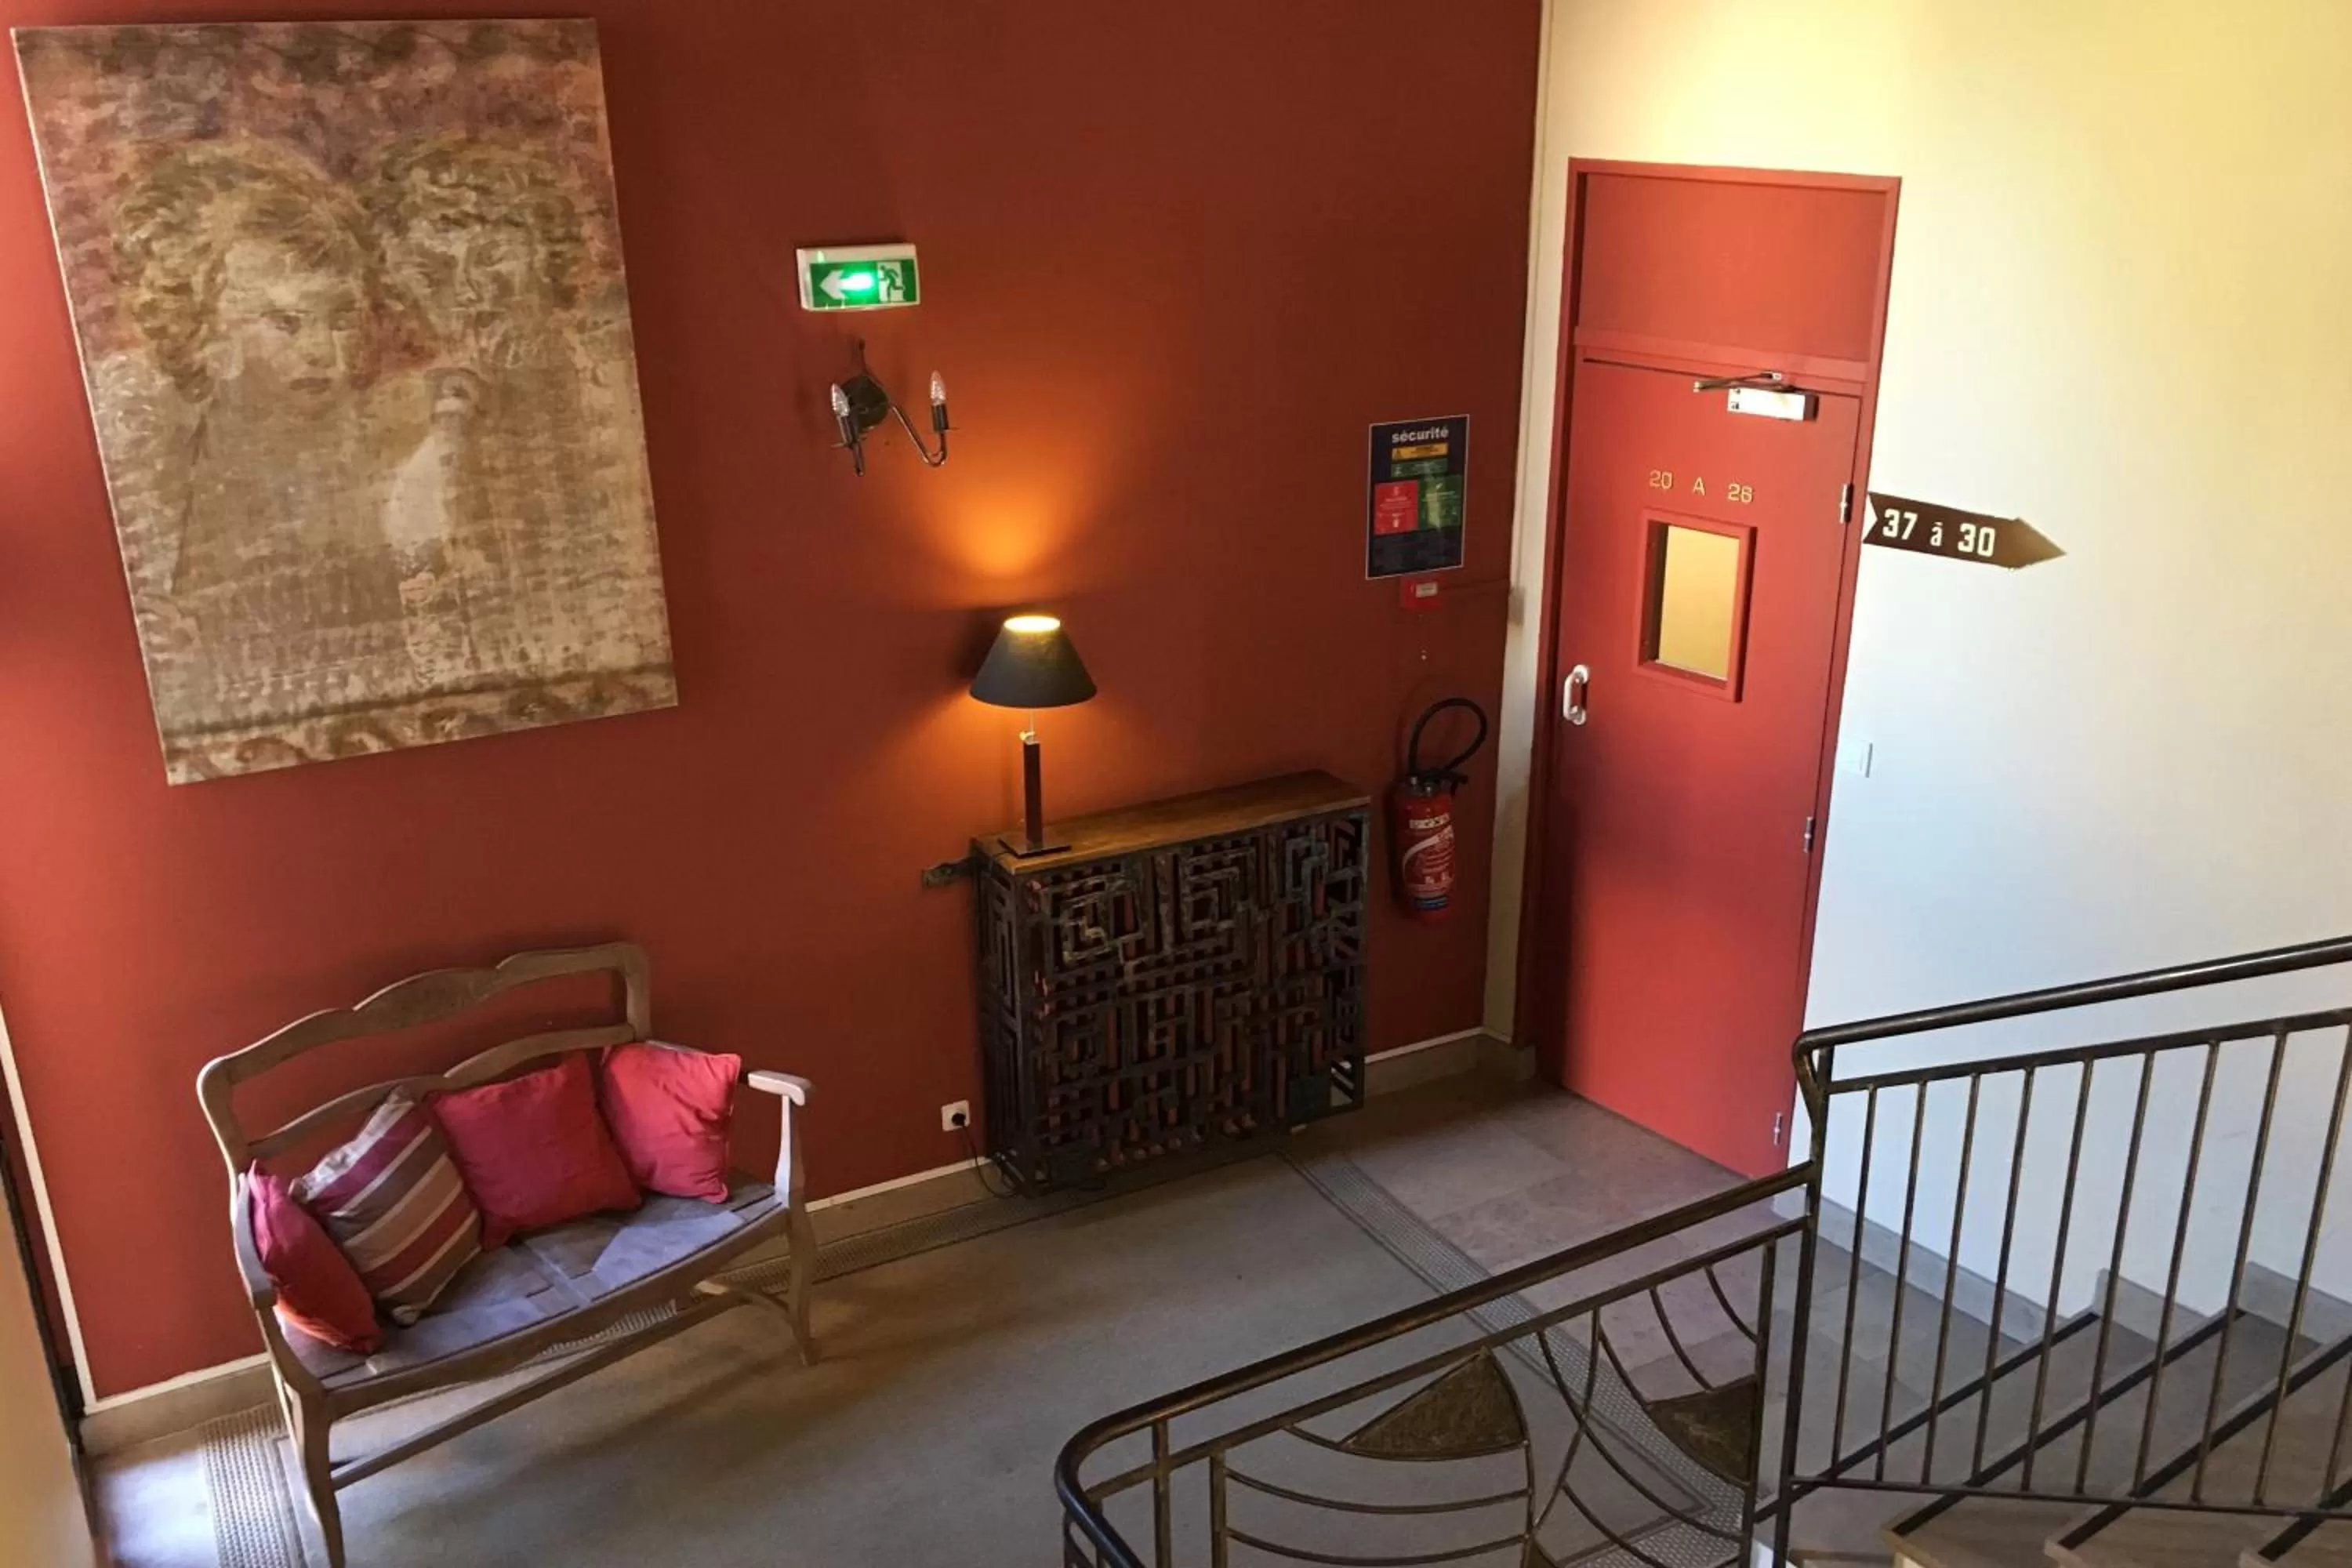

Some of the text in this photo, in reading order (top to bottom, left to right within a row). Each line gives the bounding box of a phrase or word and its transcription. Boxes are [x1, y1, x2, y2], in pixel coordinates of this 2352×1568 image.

[1391, 426, 1450, 443] sécurité
[1649, 470, 1673, 490] 20
[1692, 477, 1705, 496] A
[1882, 508, 1996, 557] 37 à 30
